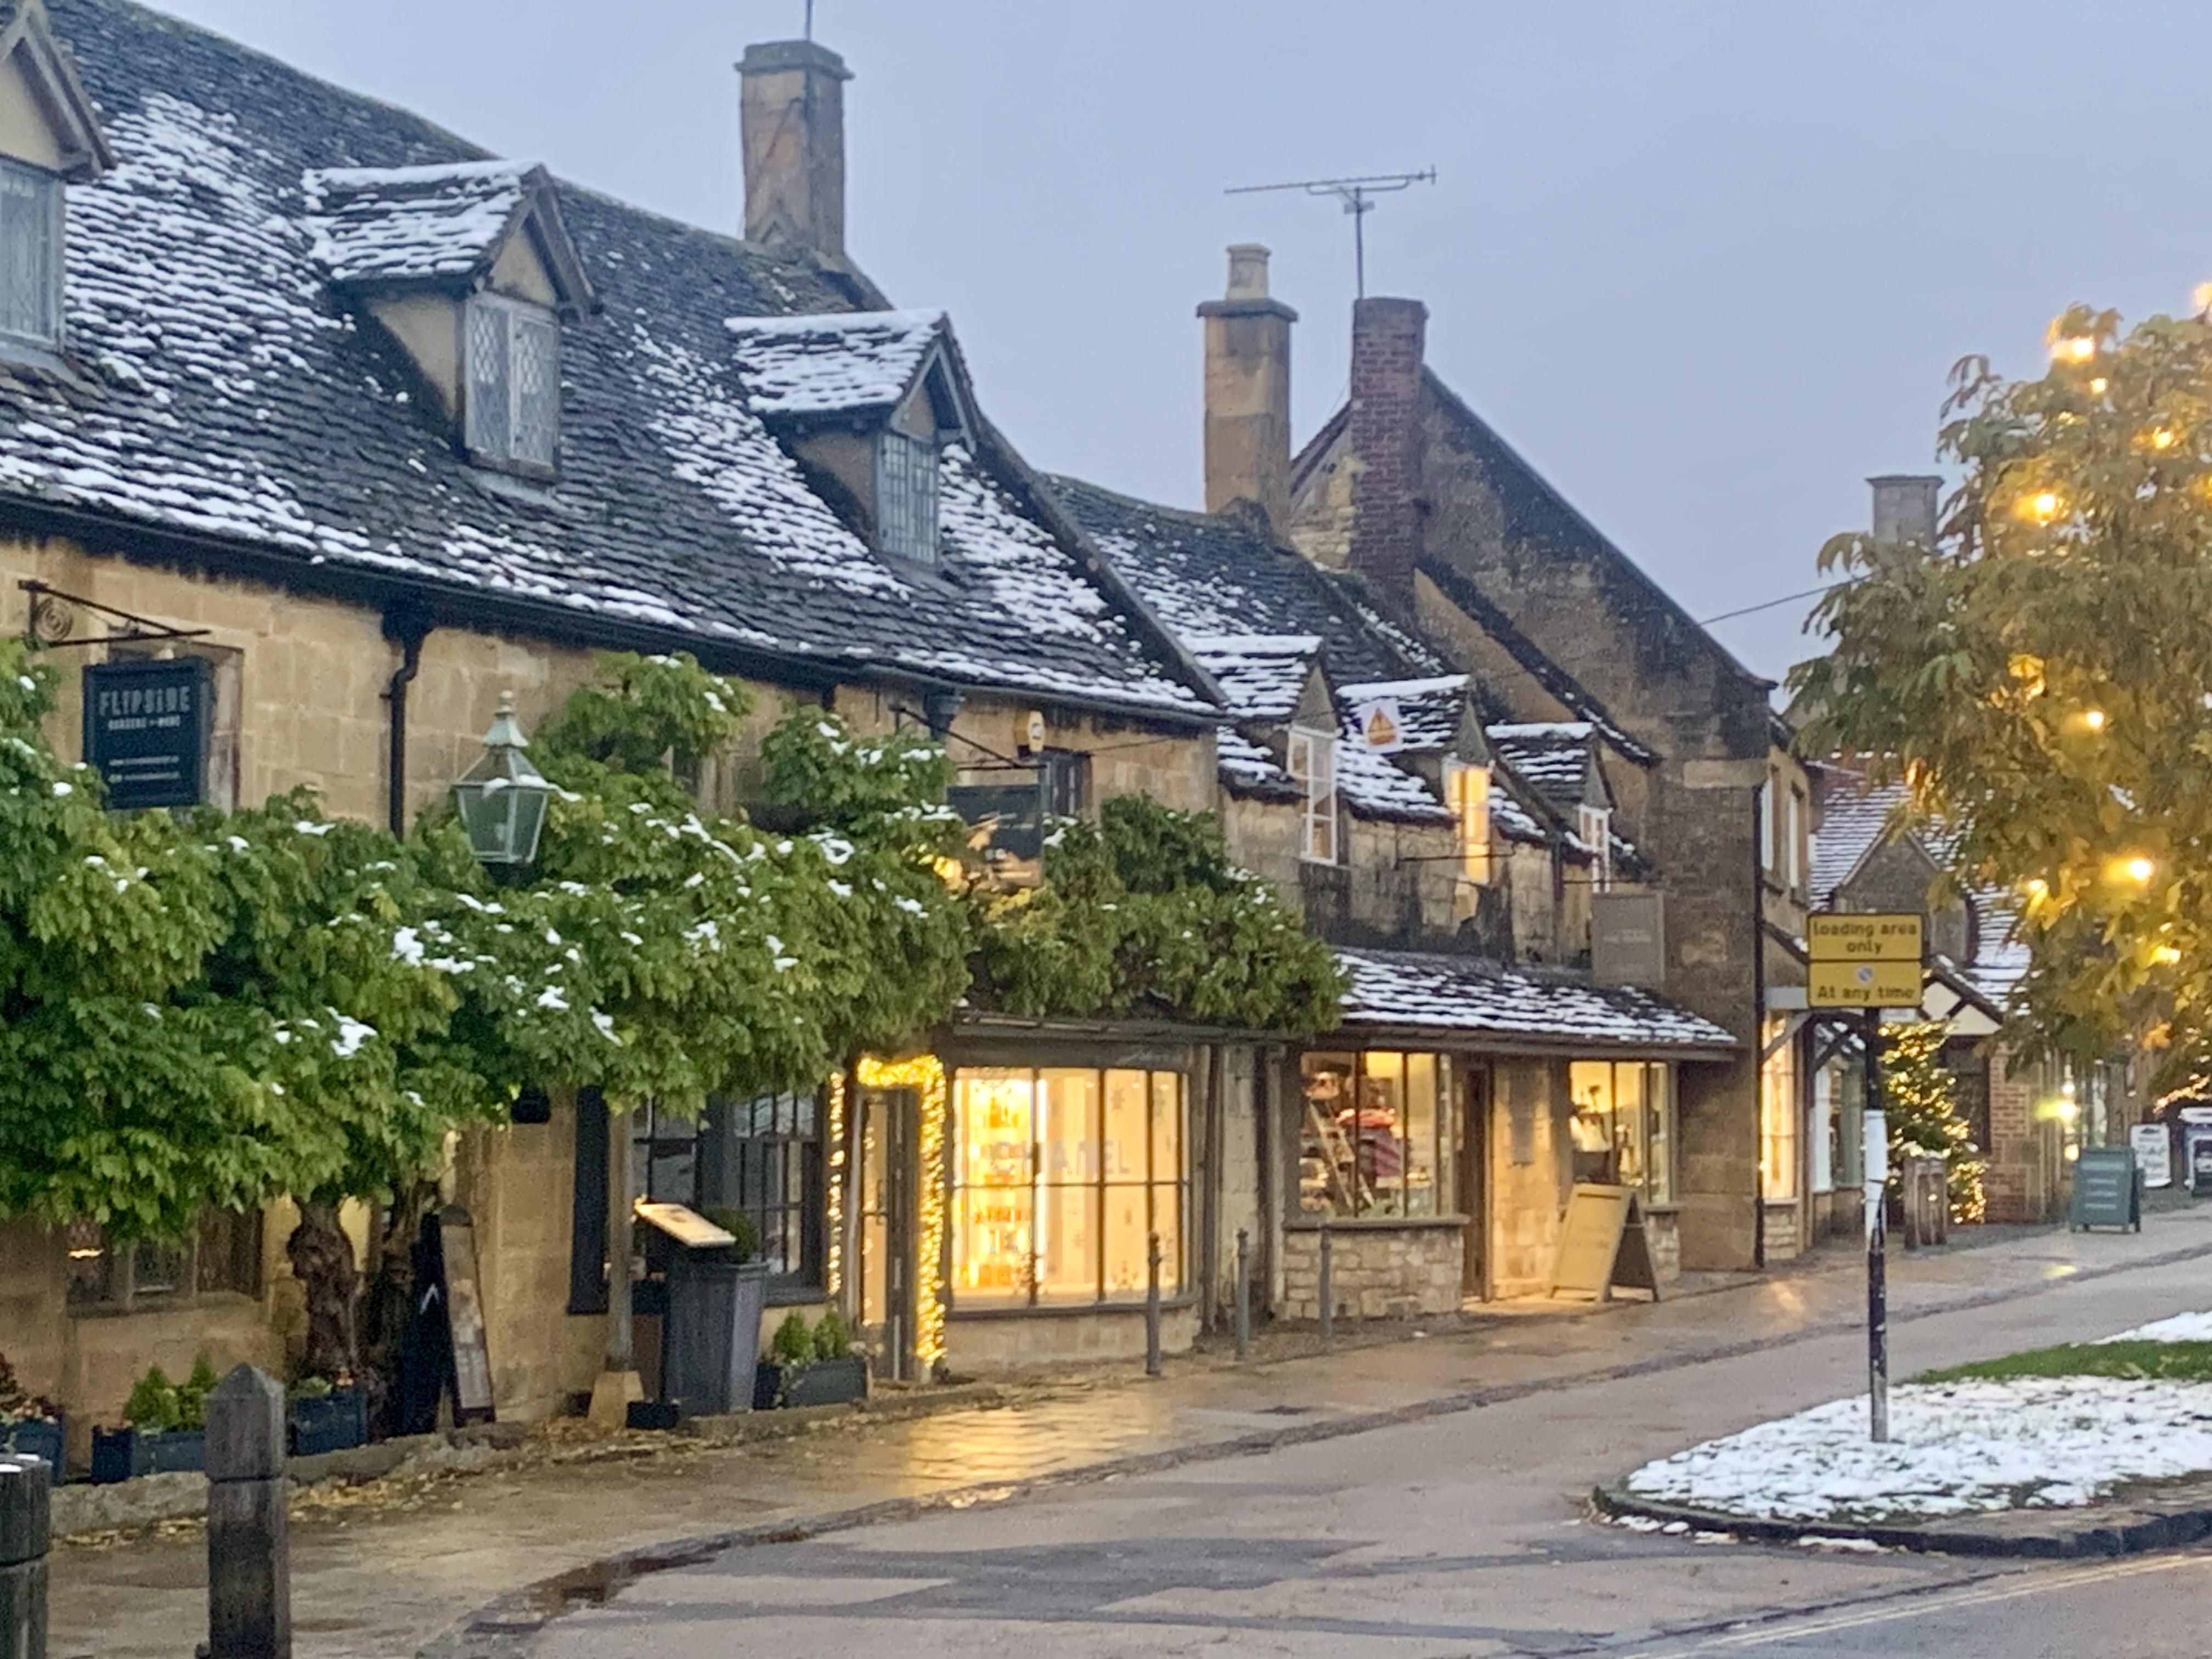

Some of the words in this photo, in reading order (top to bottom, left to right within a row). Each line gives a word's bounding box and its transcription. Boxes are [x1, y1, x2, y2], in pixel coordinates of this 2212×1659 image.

[1814, 922, 1874, 937] Loading
[1881, 924, 1917, 935] area
[1846, 940, 1882, 953] only
[1818, 986, 1835, 998] At
[1842, 988, 1870, 1001] any
[1877, 987, 1914, 998] time
